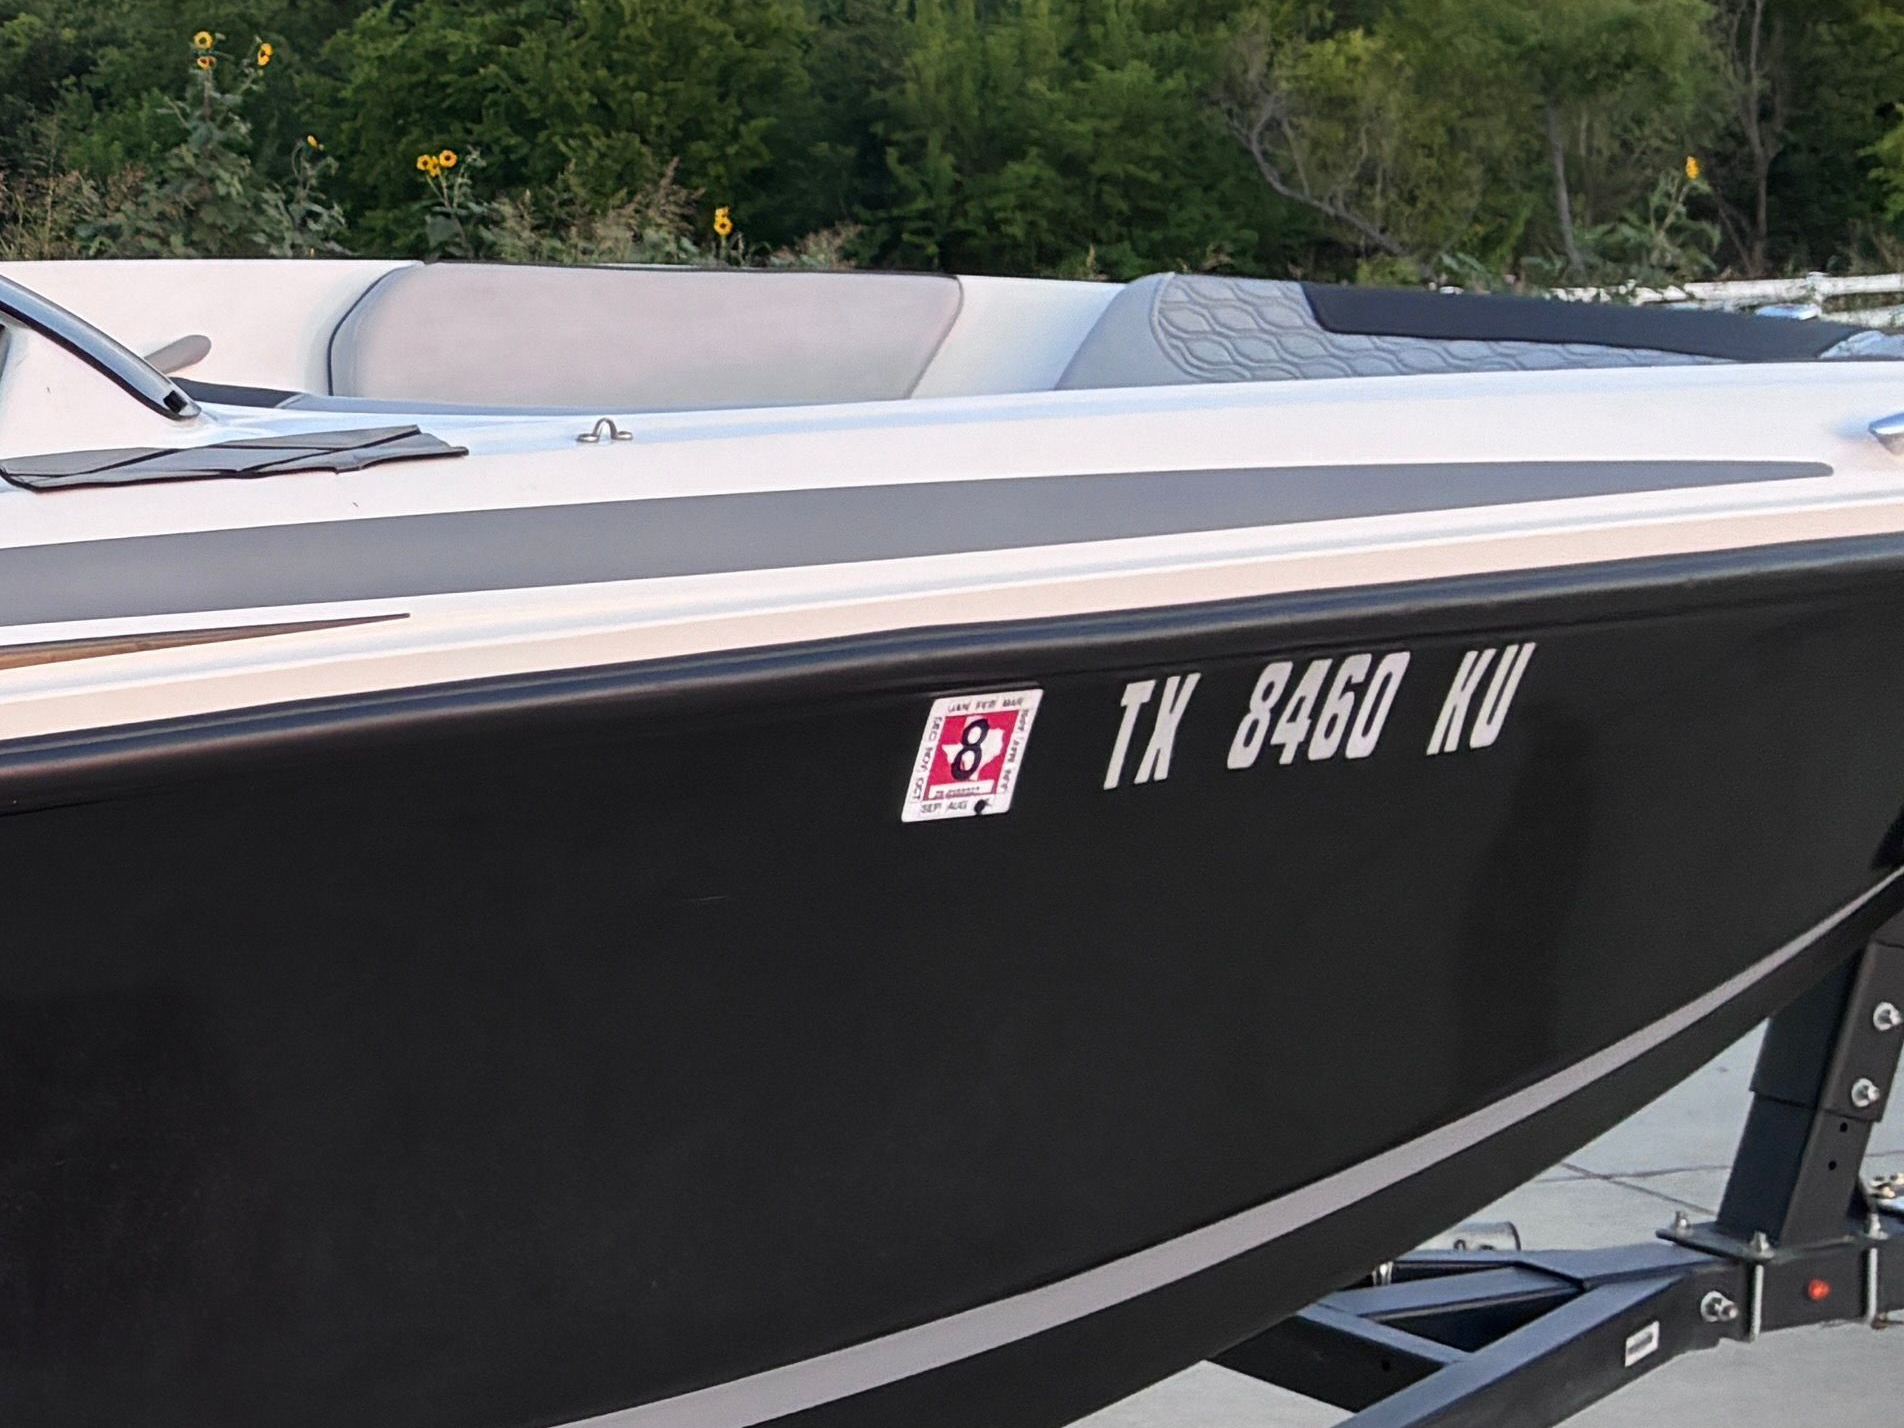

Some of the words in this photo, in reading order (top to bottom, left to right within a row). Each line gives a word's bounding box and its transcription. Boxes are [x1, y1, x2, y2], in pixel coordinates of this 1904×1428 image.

[950, 718, 990, 781] 8
[1104, 673, 1200, 789] TX
[1227, 652, 1410, 769] 8460
[1427, 642, 1536, 755] KU
